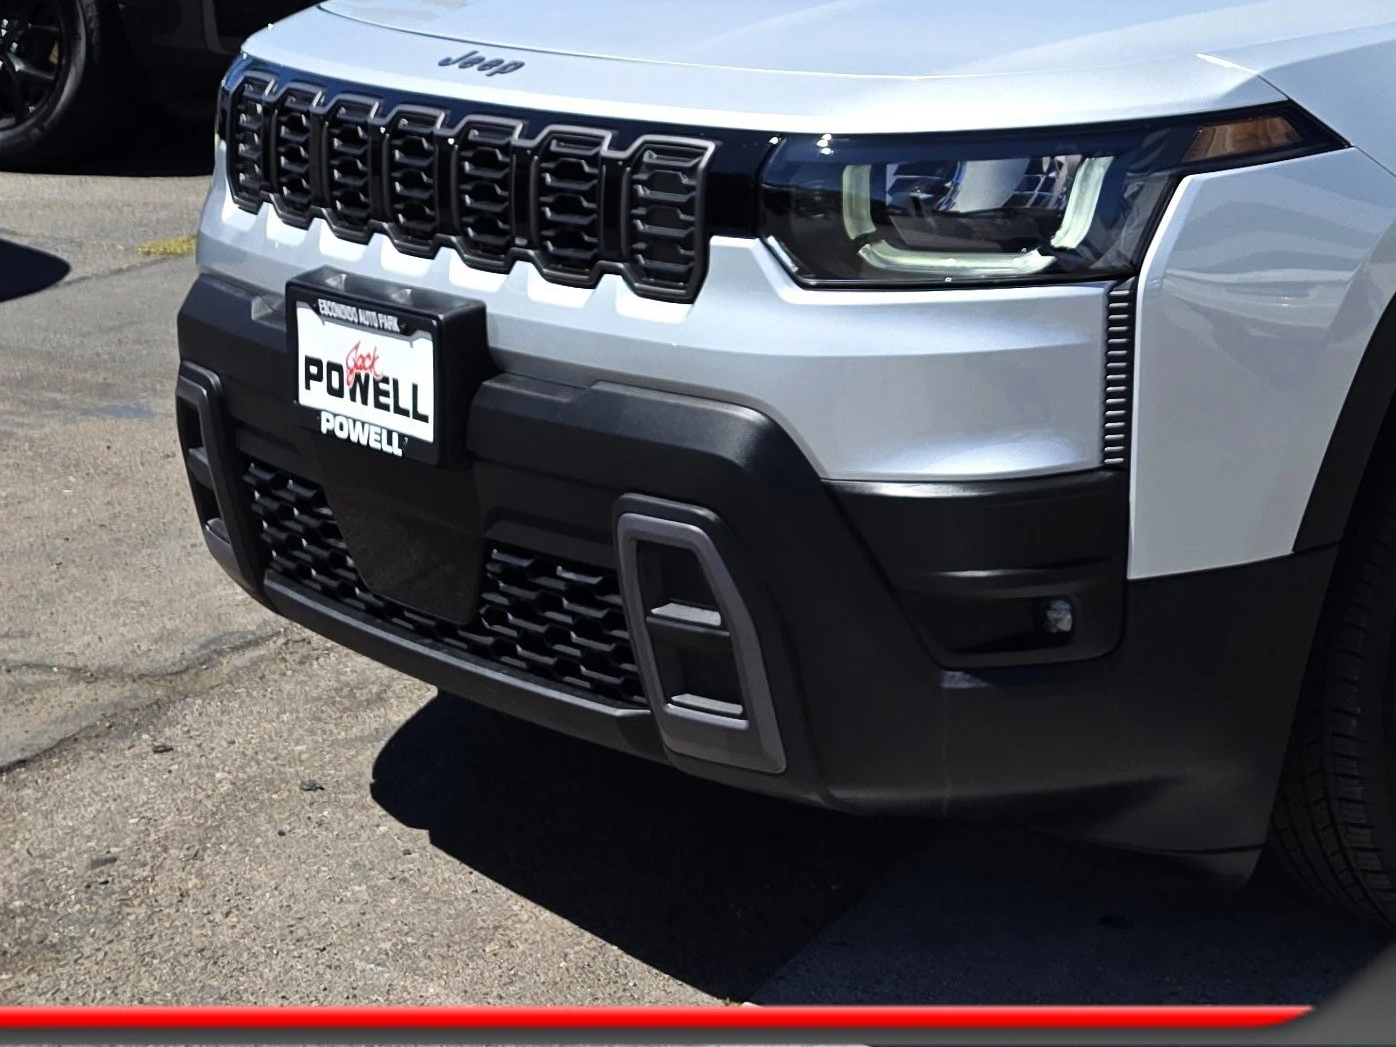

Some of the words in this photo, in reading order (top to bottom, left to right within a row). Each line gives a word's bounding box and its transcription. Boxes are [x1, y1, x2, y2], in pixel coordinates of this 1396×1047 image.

[437, 50, 526, 77] Jeep
[317, 298, 359, 325] ESCONDIDO
[358, 308, 379, 329] AUTO
[377, 313, 401, 333] PARK
[345, 340, 383, 388] Jack
[304, 354, 430, 424] POWELL
[320, 410, 403, 457] POWELL
